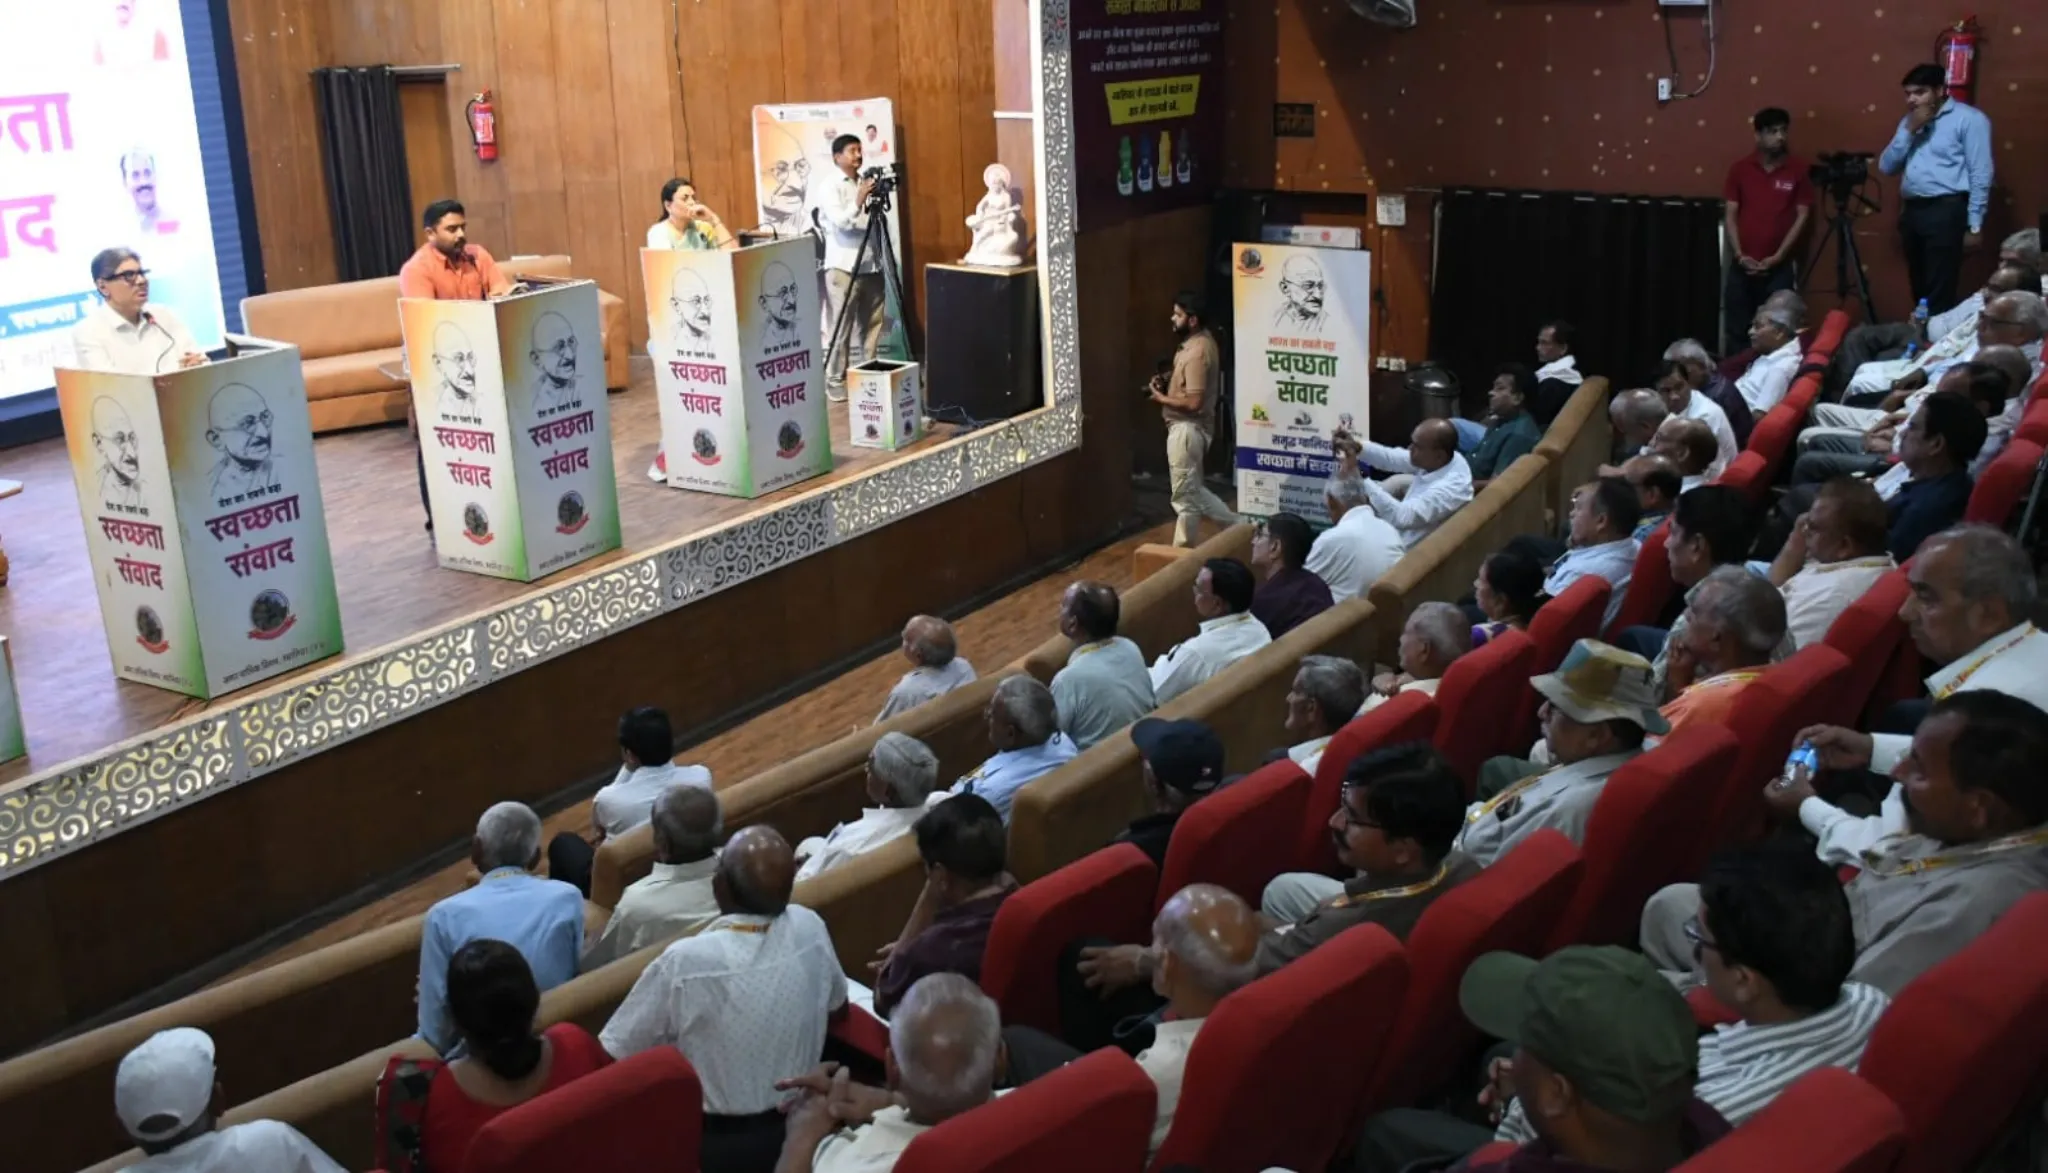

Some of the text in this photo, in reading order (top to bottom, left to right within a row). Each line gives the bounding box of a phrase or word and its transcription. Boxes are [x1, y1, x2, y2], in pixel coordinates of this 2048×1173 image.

[669, 360, 727, 386] स्वच्छता
[756, 348, 810, 382] स्वच्छता
[1266, 350, 1338, 378] स्वच्छता
[679, 388, 722, 417] संवाद
[766, 381, 806, 410] संवाद
[1276, 376, 1330, 406] संवाद
[433, 425, 495, 455] स्वच्छता
[528, 410, 594, 448] स्वच्छता
[446, 459, 492, 489] संवाद
[541, 446, 590, 480] संवाद
[1256, 452, 1295, 469] स्वच्छता
[1296, 453, 1308, 472] में
[205, 494, 300, 542] स्वच्छता
[98, 516, 165, 551] स्वच्छता
[114, 553, 164, 590] संवाद
[225, 537, 295, 579] संवाद
